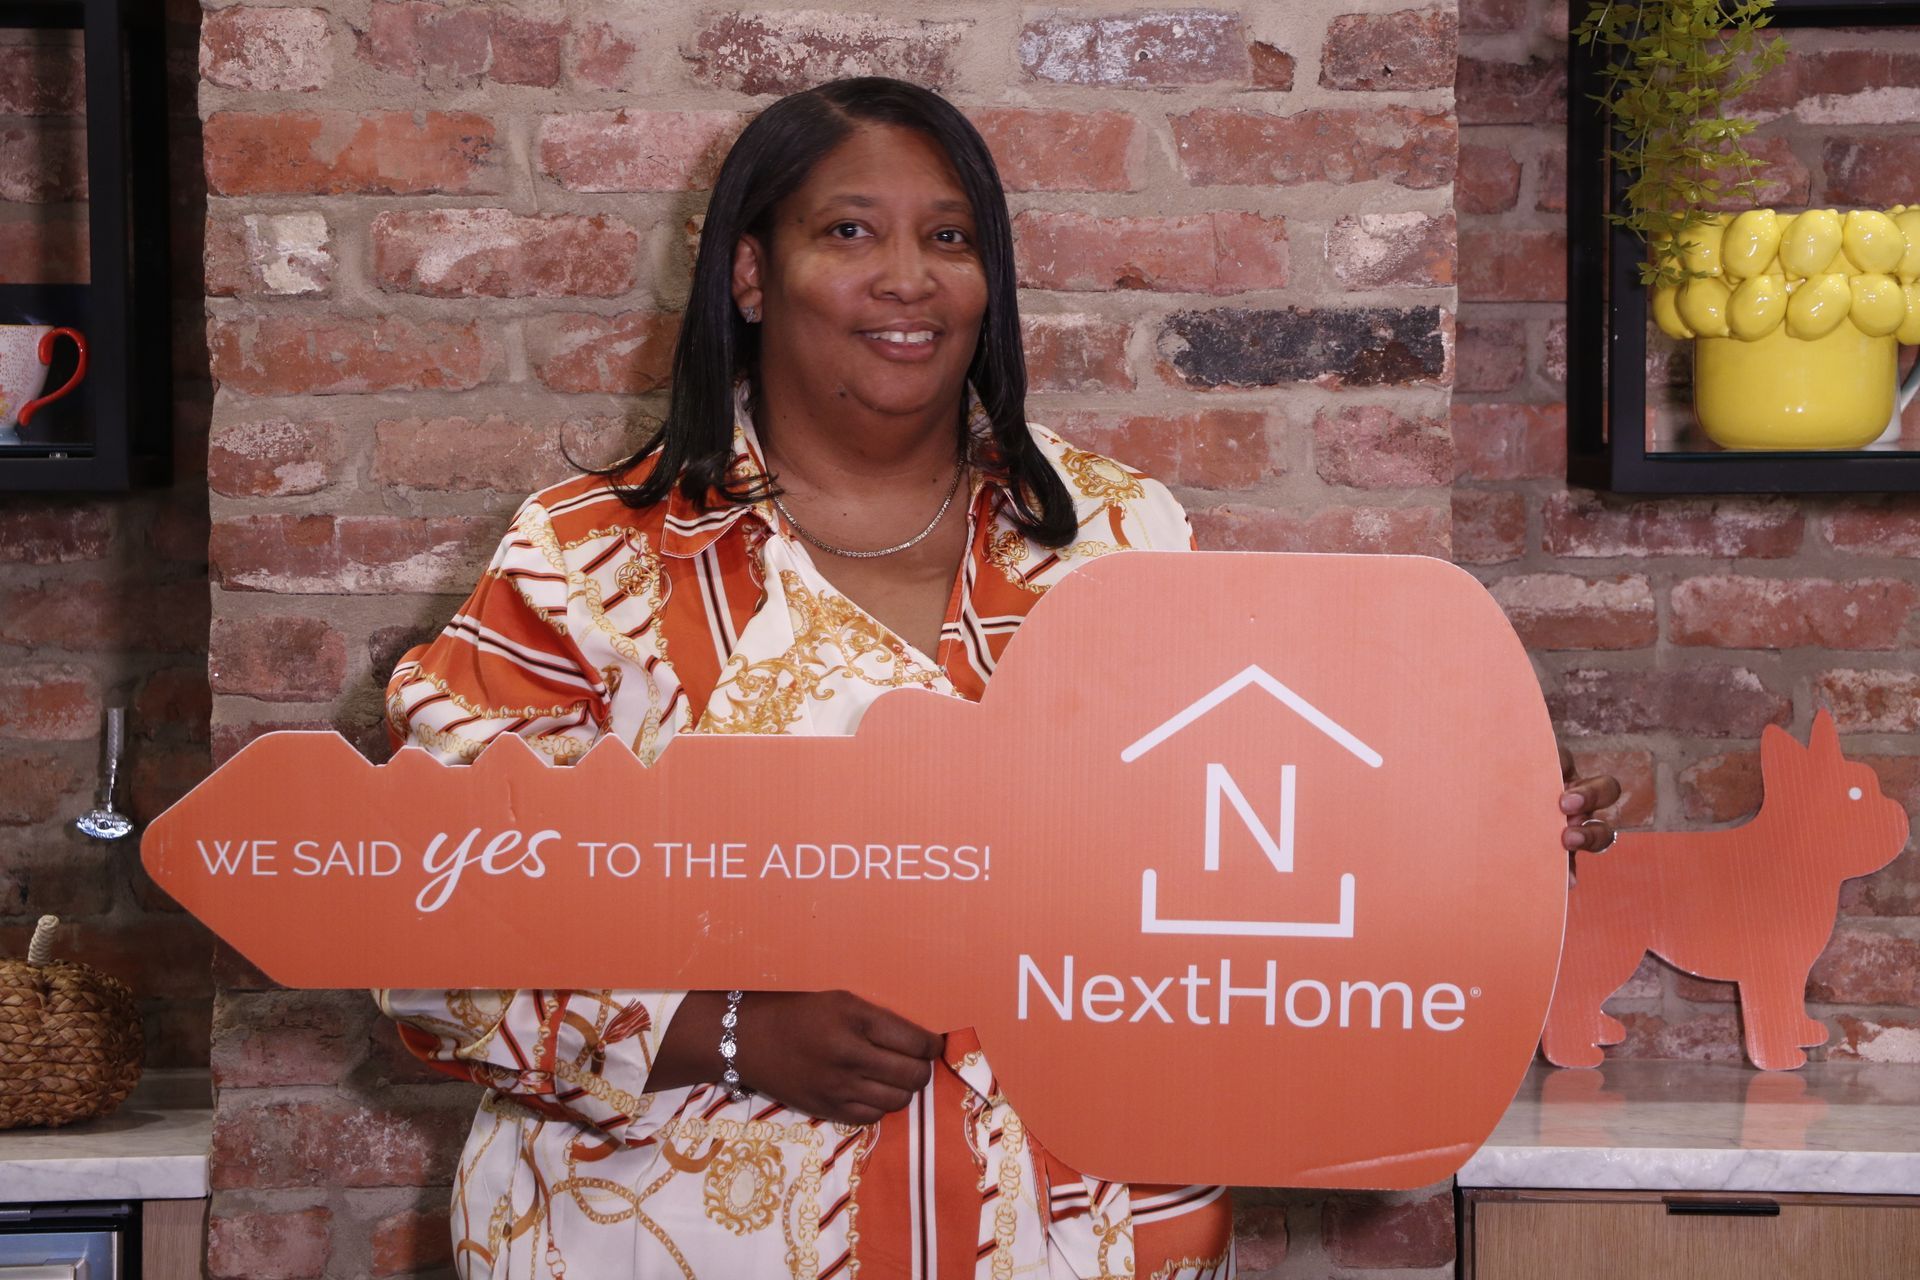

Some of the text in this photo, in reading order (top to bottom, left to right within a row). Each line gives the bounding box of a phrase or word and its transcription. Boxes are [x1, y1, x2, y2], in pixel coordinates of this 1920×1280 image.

[1204, 763, 1296, 873] N
[196, 827, 990, 913] WE SAID yes TO THE ADDRESS!
